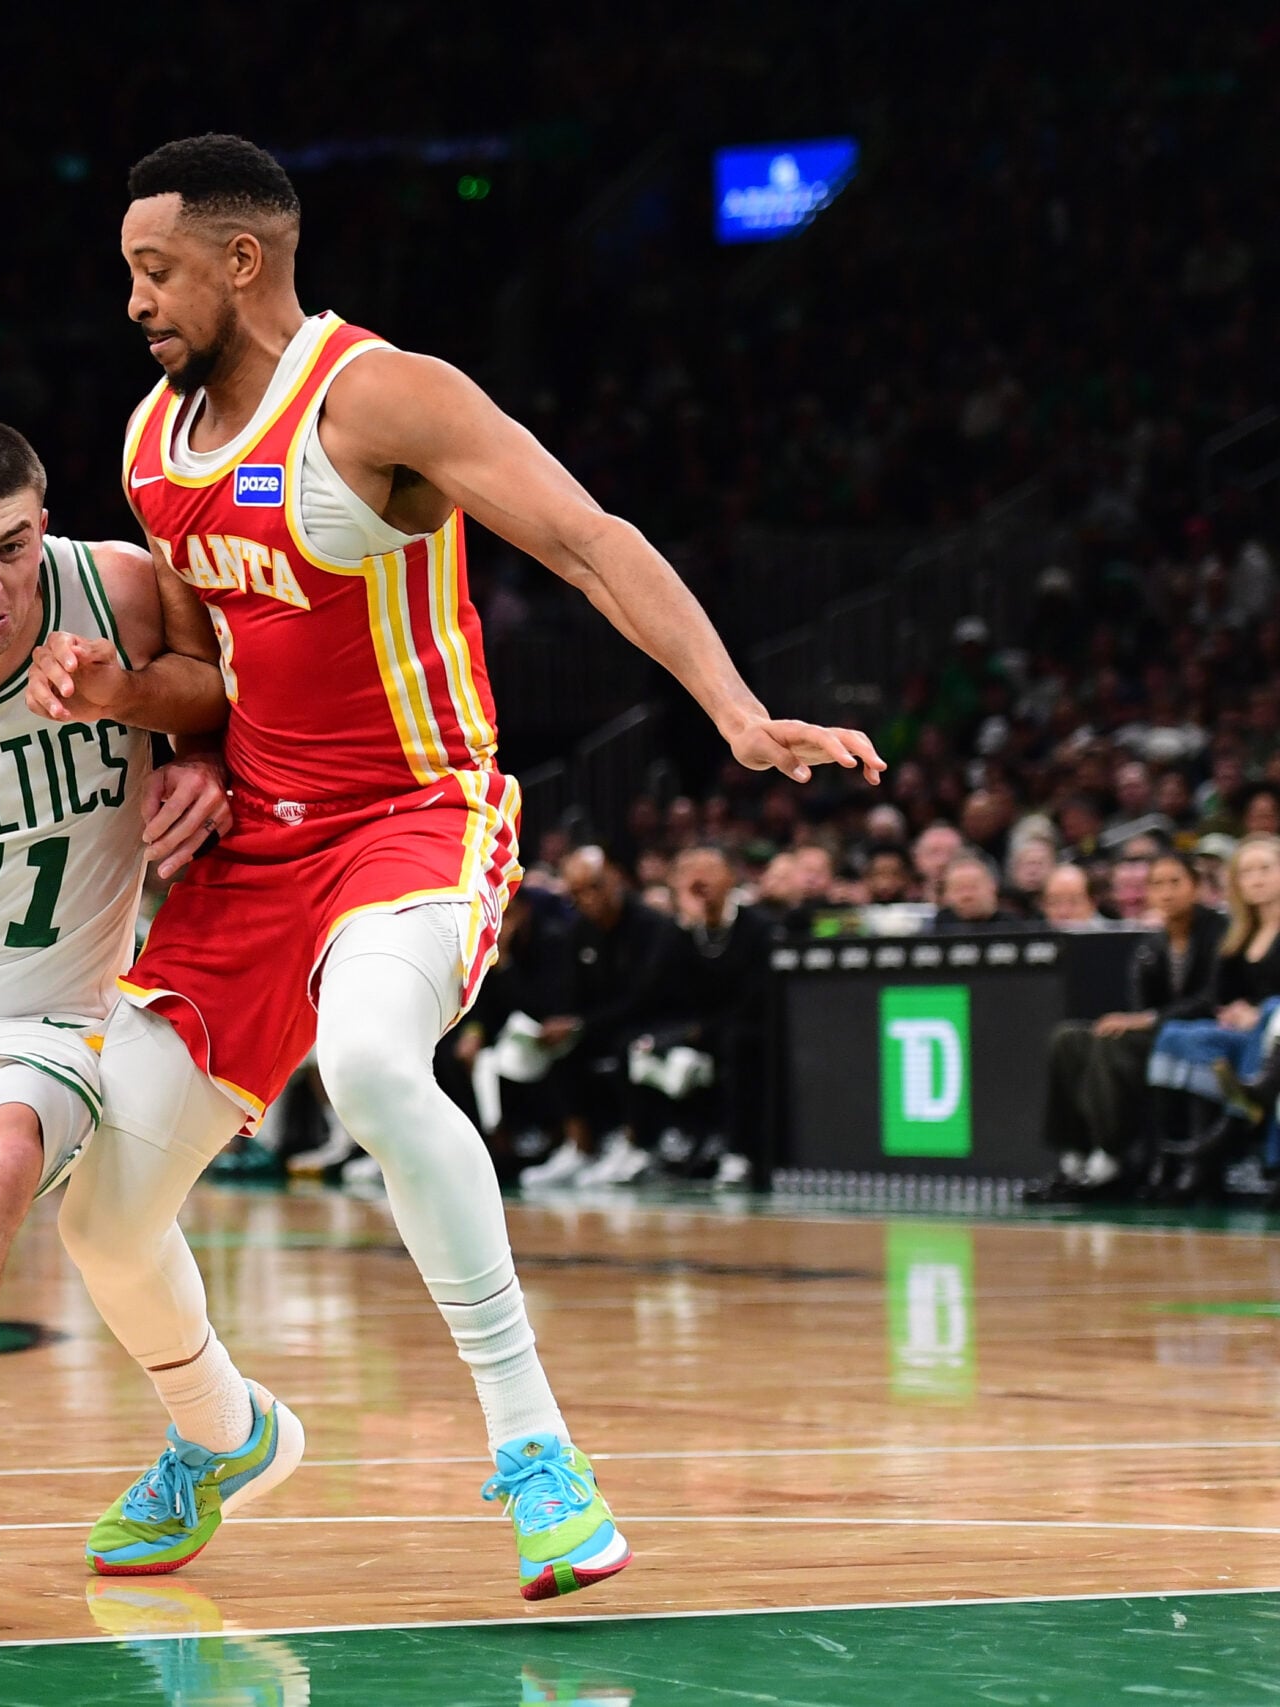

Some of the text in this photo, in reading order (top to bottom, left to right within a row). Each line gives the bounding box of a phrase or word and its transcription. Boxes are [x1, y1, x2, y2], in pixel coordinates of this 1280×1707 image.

[238, 476, 280, 495] paze
[273, 803, 308, 818] HAWKS
[886, 1018, 963, 1122] TD
